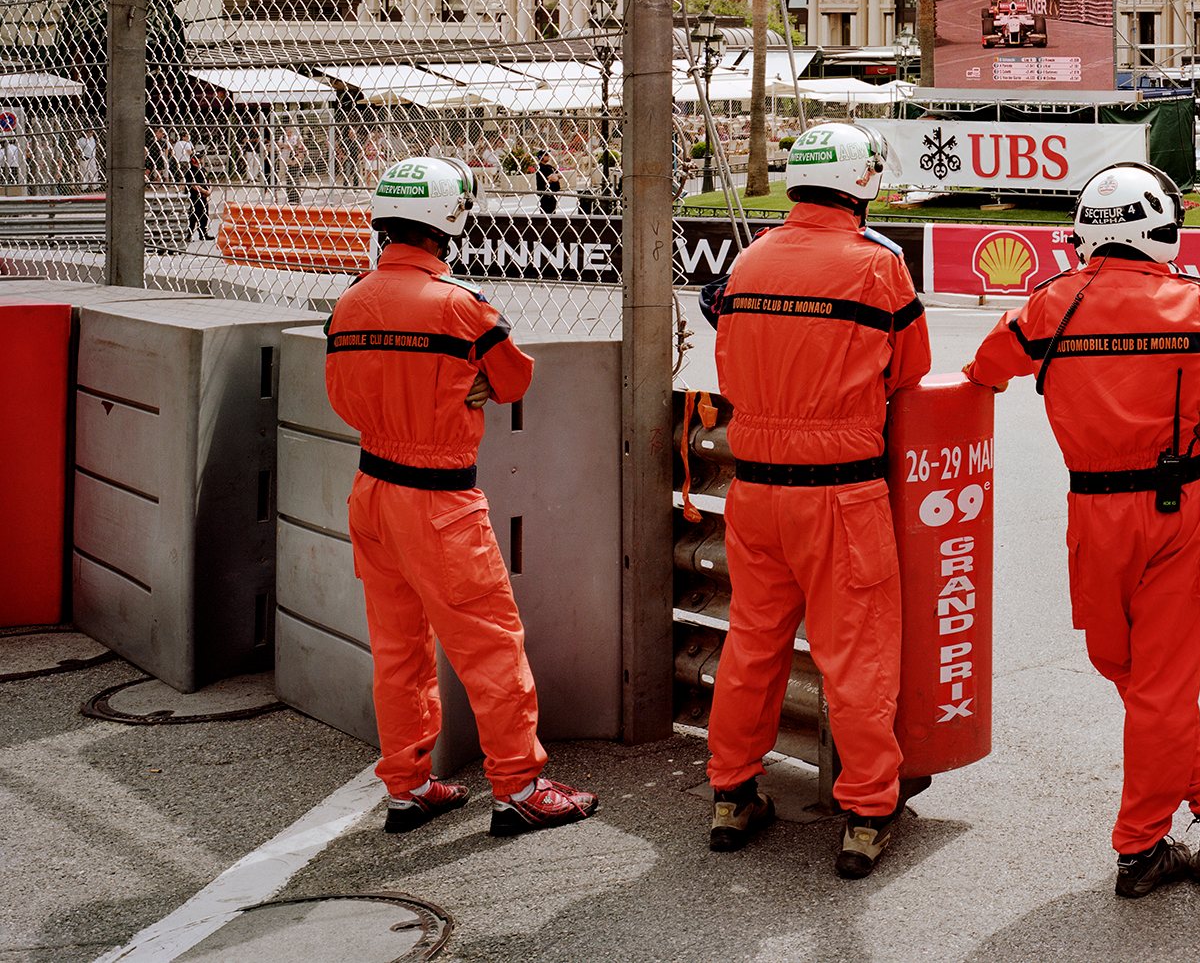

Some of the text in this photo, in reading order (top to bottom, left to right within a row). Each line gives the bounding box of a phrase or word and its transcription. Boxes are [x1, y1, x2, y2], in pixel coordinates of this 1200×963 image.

[796, 130, 834, 146] 457
[789, 150, 833, 162] INTERVENTION
[967, 133, 1069, 181] UBS
[387, 163, 428, 180] 425
[378, 184, 425, 195] INTERVENTION
[1084, 204, 1136, 219] SECTEUR 4
[1091, 216, 1127, 225] ALPHA
[762, 299, 781, 312] CLUB
[783, 300, 793, 313] DE
[794, 301, 833, 315] MONACO
[383, 334, 394, 346] DE
[395, 335, 429, 348] MONACO
[1056, 336, 1190, 353] AUTOMOBILE CLUB DE MONACO
[905, 437, 993, 483] 26-29 MAI
[937, 535, 976, 635] GRAND
[936, 641, 974, 723] PRIX
